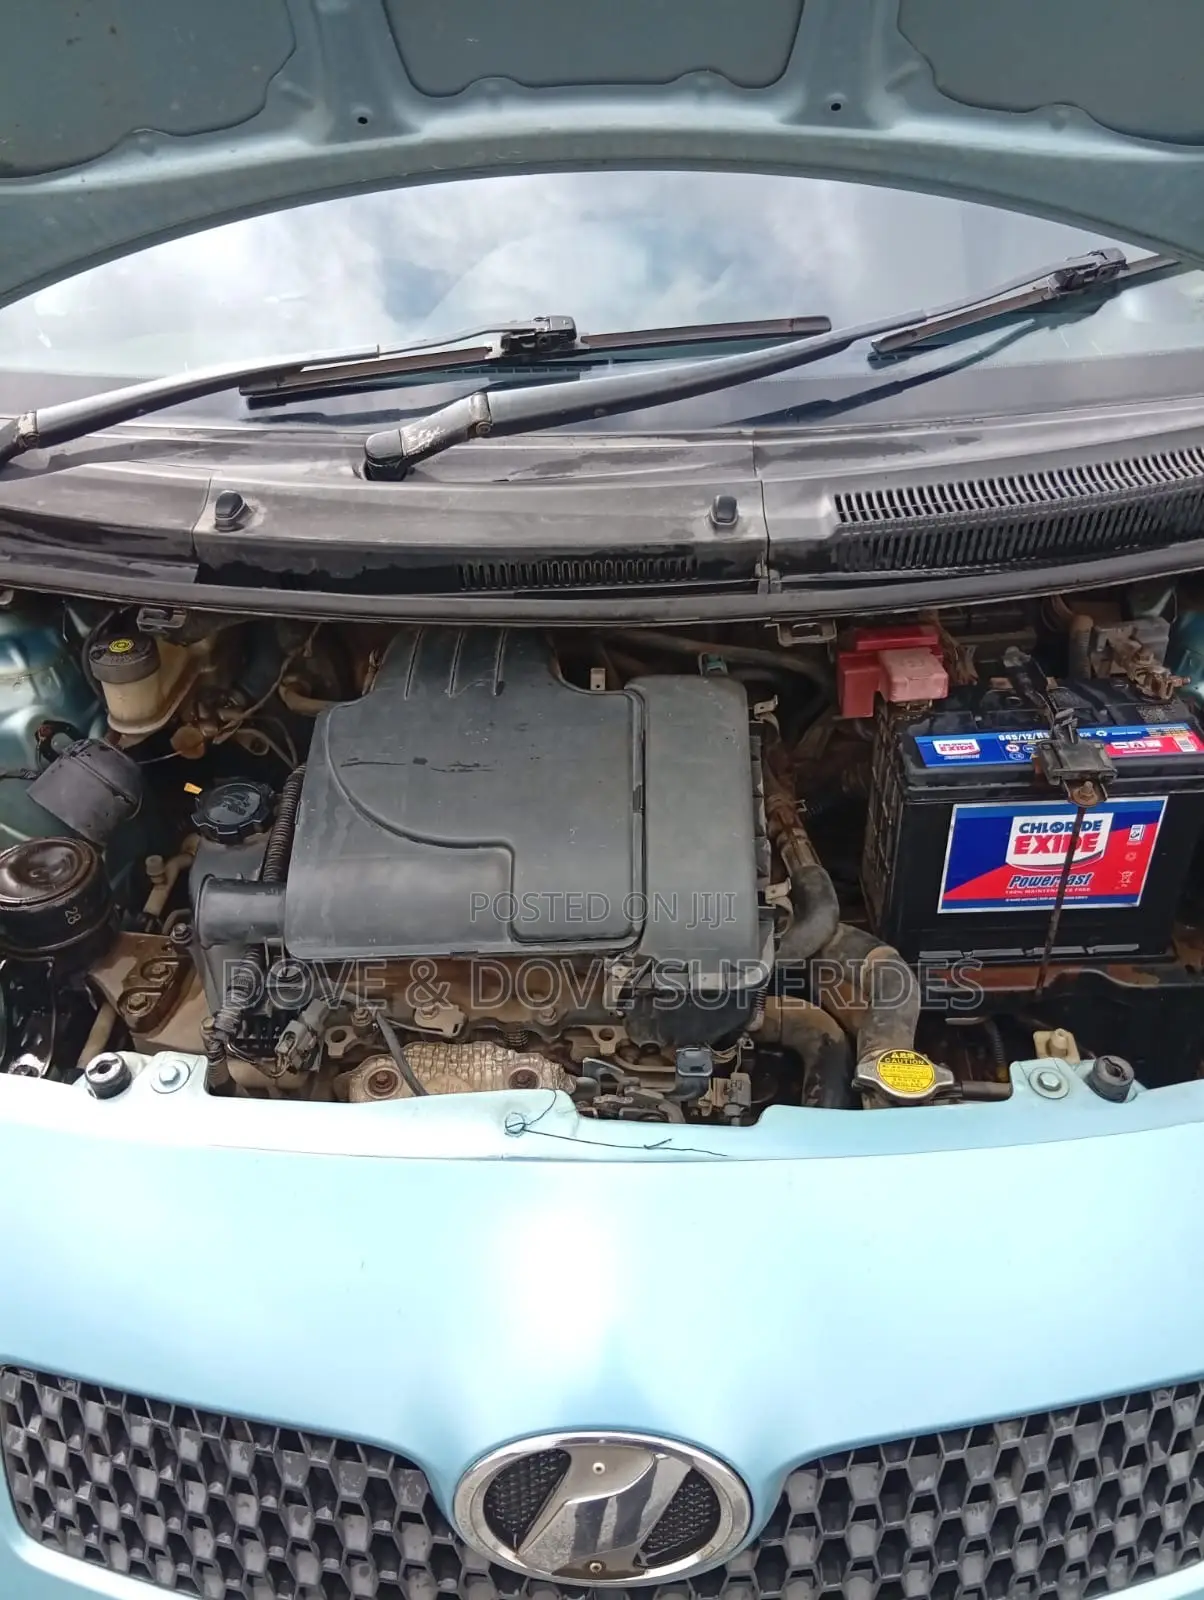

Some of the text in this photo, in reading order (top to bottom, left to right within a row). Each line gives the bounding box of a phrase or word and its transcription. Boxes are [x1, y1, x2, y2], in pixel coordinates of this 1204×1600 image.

[1018, 819, 1103, 834] CHLORDE
[1007, 872, 1094, 889] Powerast
[65, 906, 81, 925] 28
[884, 1057, 925, 1065] CAUTION
